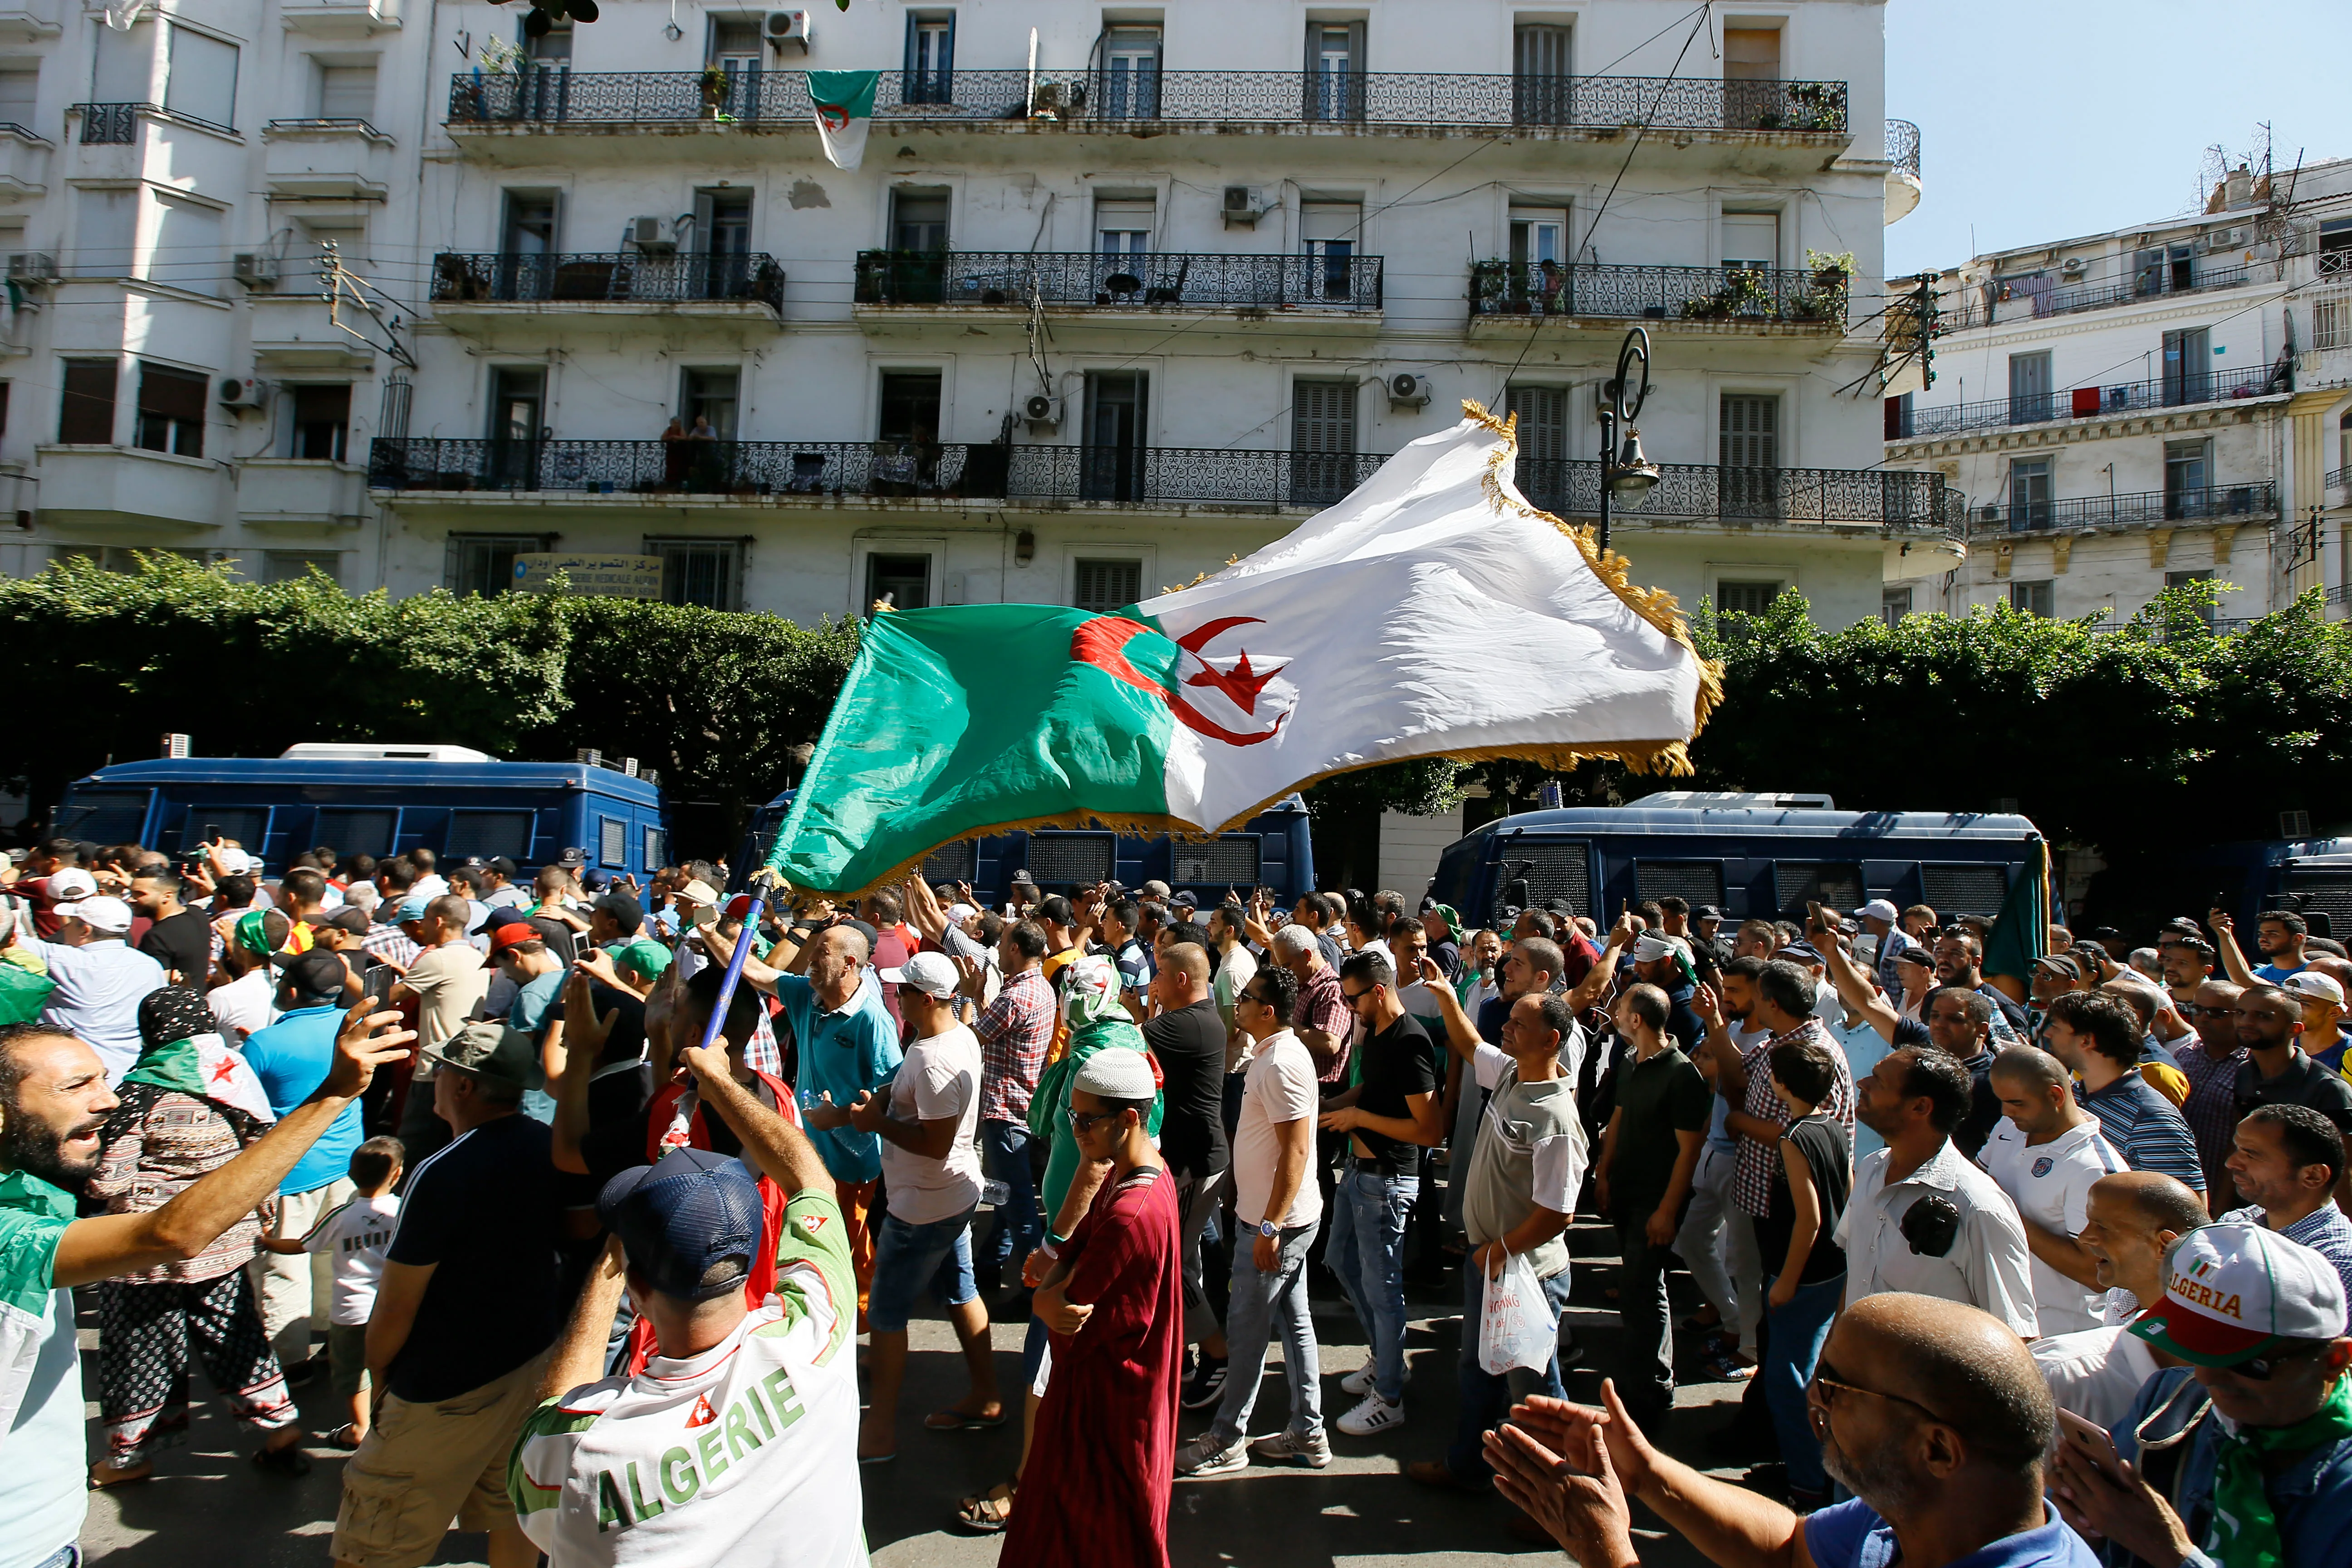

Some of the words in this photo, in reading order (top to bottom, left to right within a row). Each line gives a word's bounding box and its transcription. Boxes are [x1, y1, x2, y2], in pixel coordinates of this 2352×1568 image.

[586, 559, 629, 570] التصوير
[632, 559, 660, 572] مركز
[594, 574, 632, 584] MEDICALE
[632, 575, 659, 586] AUDIN
[584, 586, 622, 594] MALADIES
[623, 587, 635, 595] DU
[637, 587, 657, 597] SEIN
[598, 1366, 806, 1534] ALGERIE
